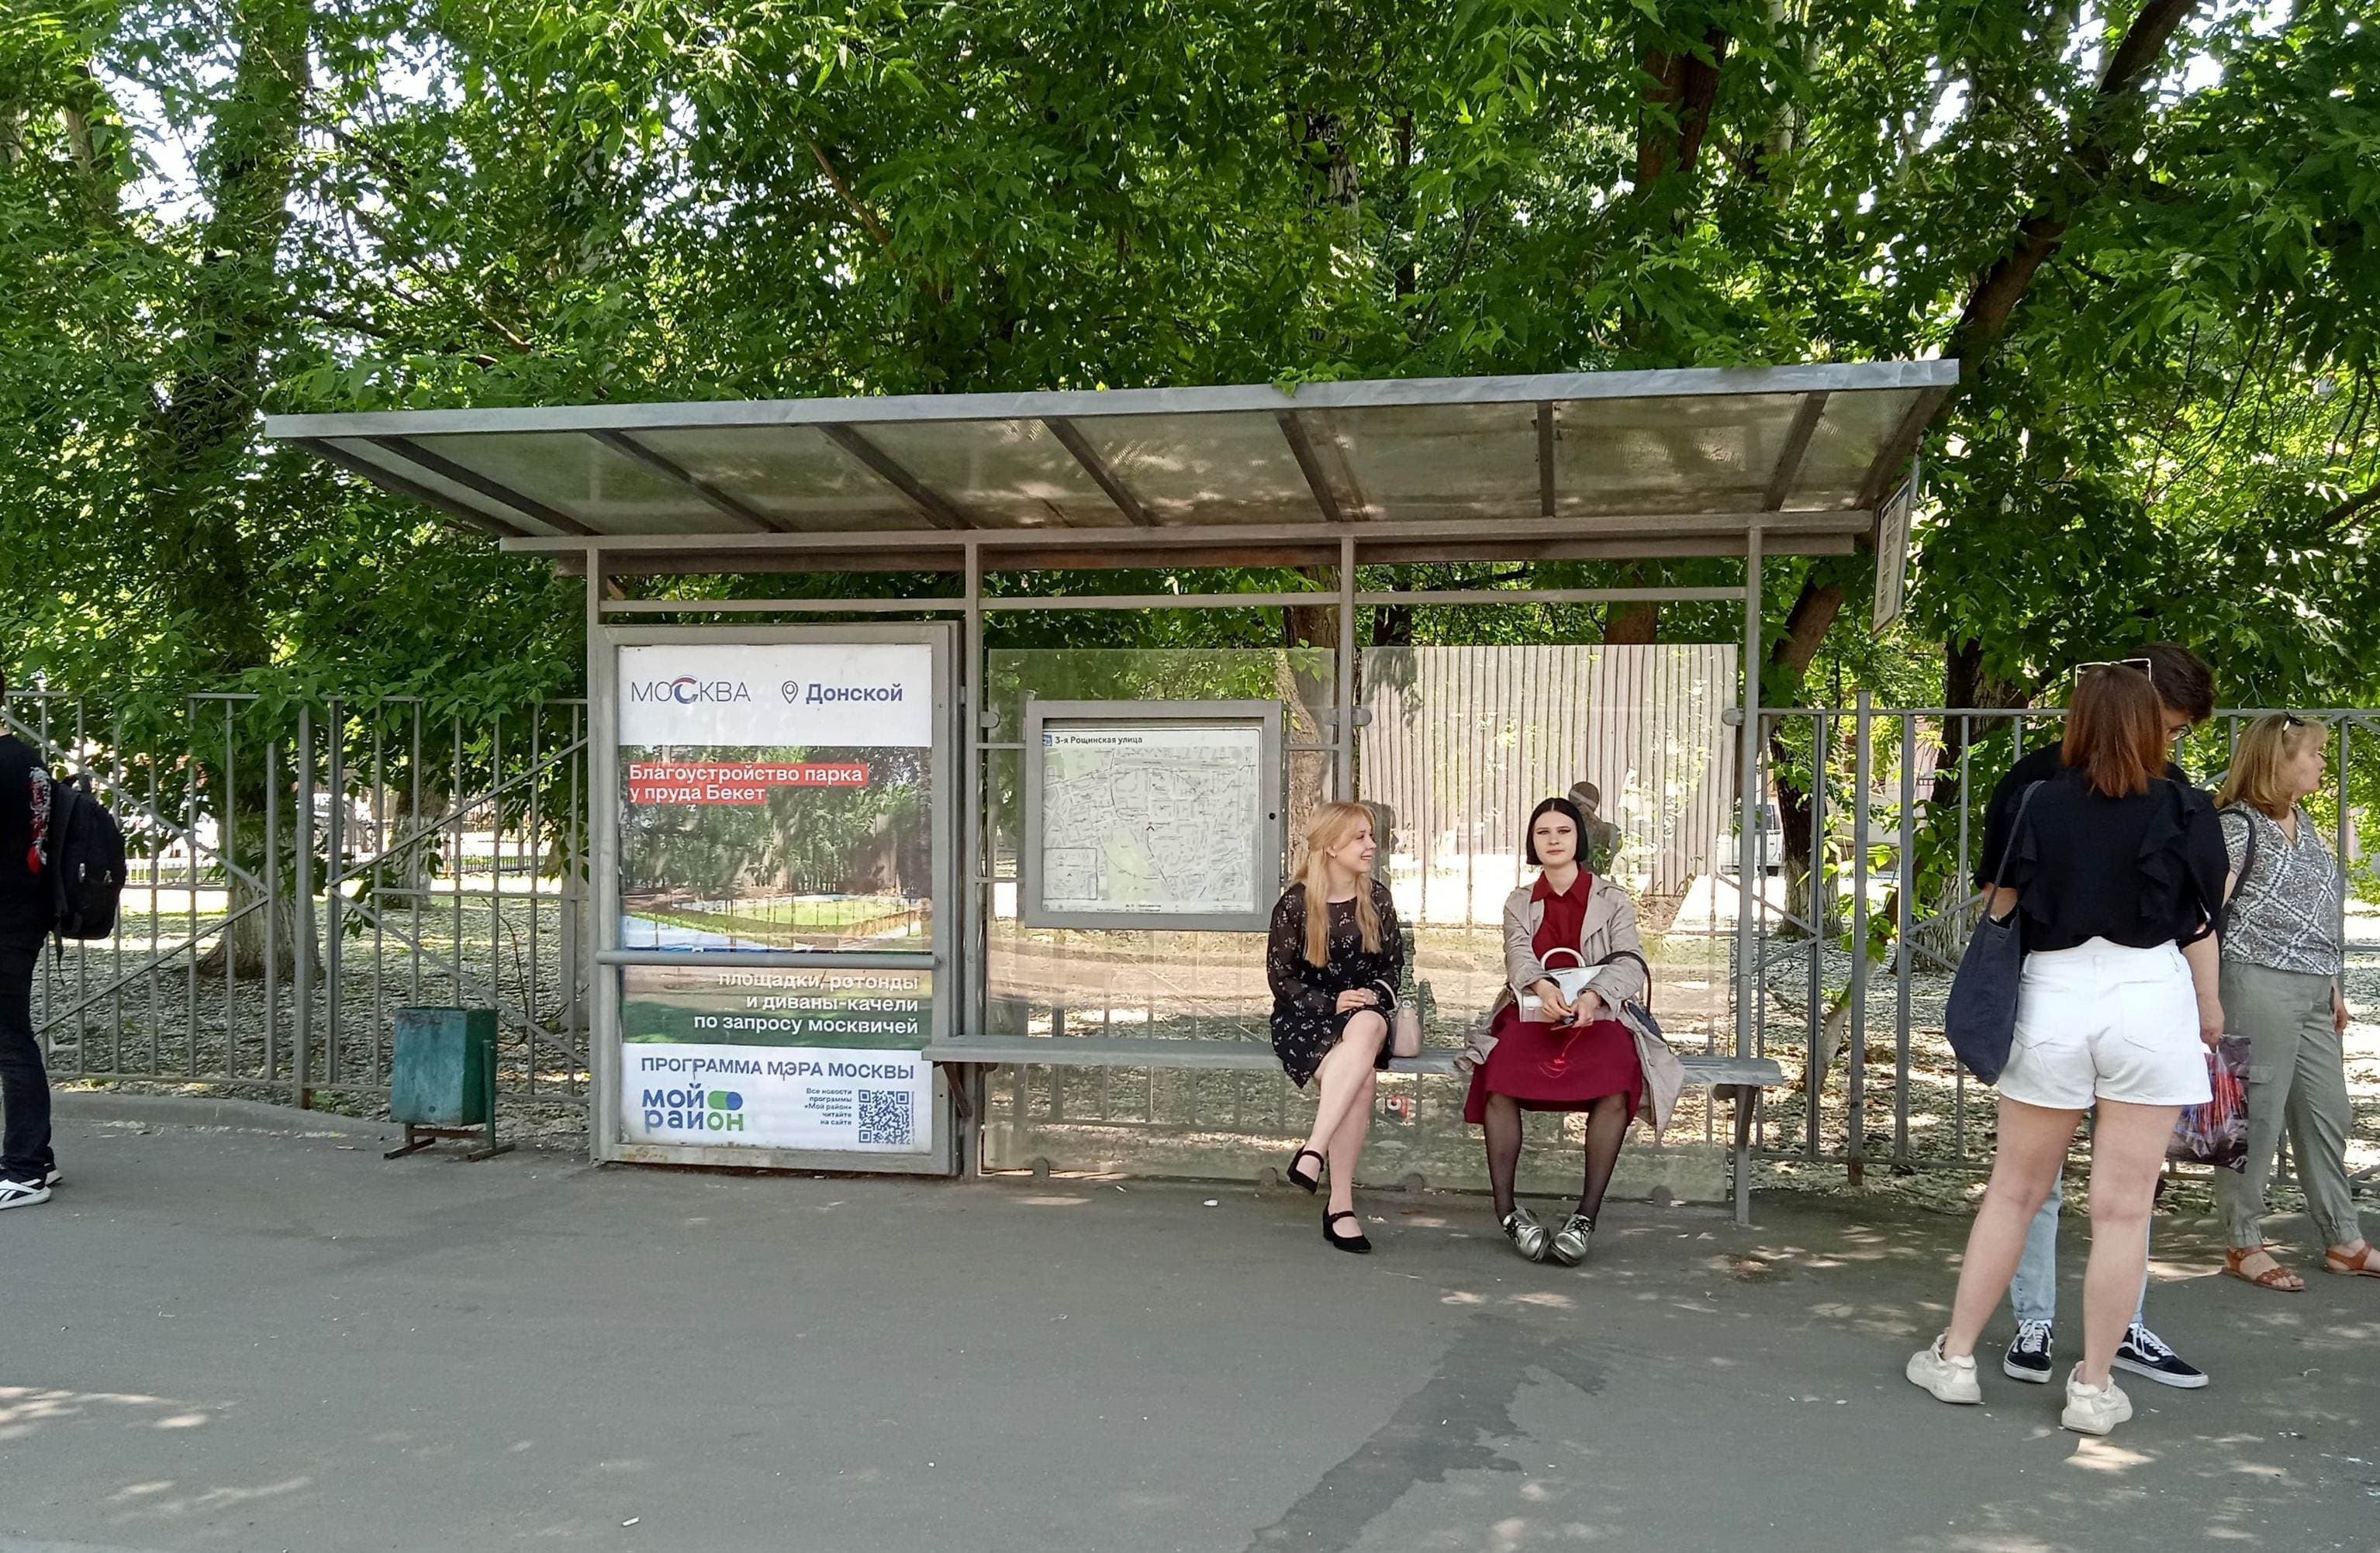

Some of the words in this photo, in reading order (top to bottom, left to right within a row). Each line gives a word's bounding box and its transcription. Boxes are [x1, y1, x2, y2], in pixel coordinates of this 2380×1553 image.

[630, 675, 751, 704] МОСКВА
[805, 683, 903, 705] Донской
[1070, 736, 1116, 744] Рощинская
[629, 764, 800, 786] Благоустройство
[804, 772, 862, 785] парка
[630, 787, 640, 802] у
[644, 787, 702, 802] пруда
[706, 785, 765, 800] Бекет
[718, 974, 824, 988] площадки,
[830, 977, 918, 992] ротонды
[746, 997, 758, 1008] и
[762, 997, 918, 1012] диваны-качели
[694, 1017, 717, 1028] по
[723, 1018, 802, 1034] запросу
[809, 1019, 918, 1034] москвичей
[641, 1058, 762, 1075] ПРОГРАММА
[767, 1061, 823, 1076] МЭРА
[828, 1062, 914, 1079] МОСКВЫ
